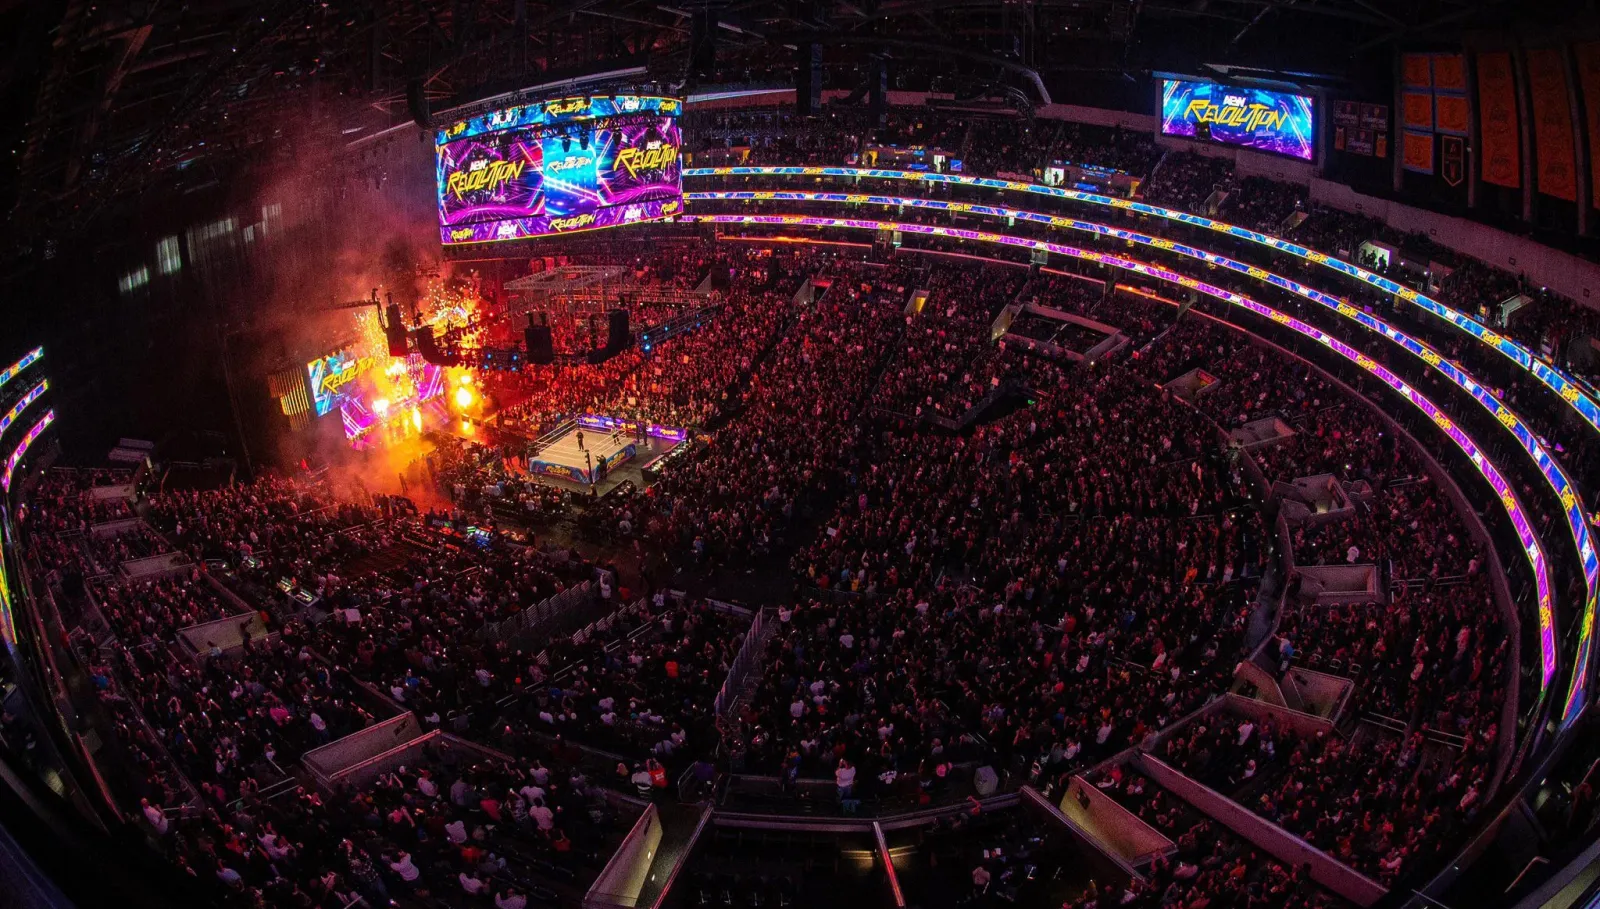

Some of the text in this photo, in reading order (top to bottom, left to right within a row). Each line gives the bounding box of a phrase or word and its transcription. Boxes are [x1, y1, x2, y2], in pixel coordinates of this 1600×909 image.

[1223, 95, 1247, 108] AEW
[1184, 100, 1289, 132] REVOLUTION
[646, 140, 662, 151] AEW
[470, 159, 488, 171] AEW
[613, 144, 679, 179] REVOLUTION
[446, 160, 525, 201] REVOLUTION
[549, 214, 597, 232] REVOLUTION
